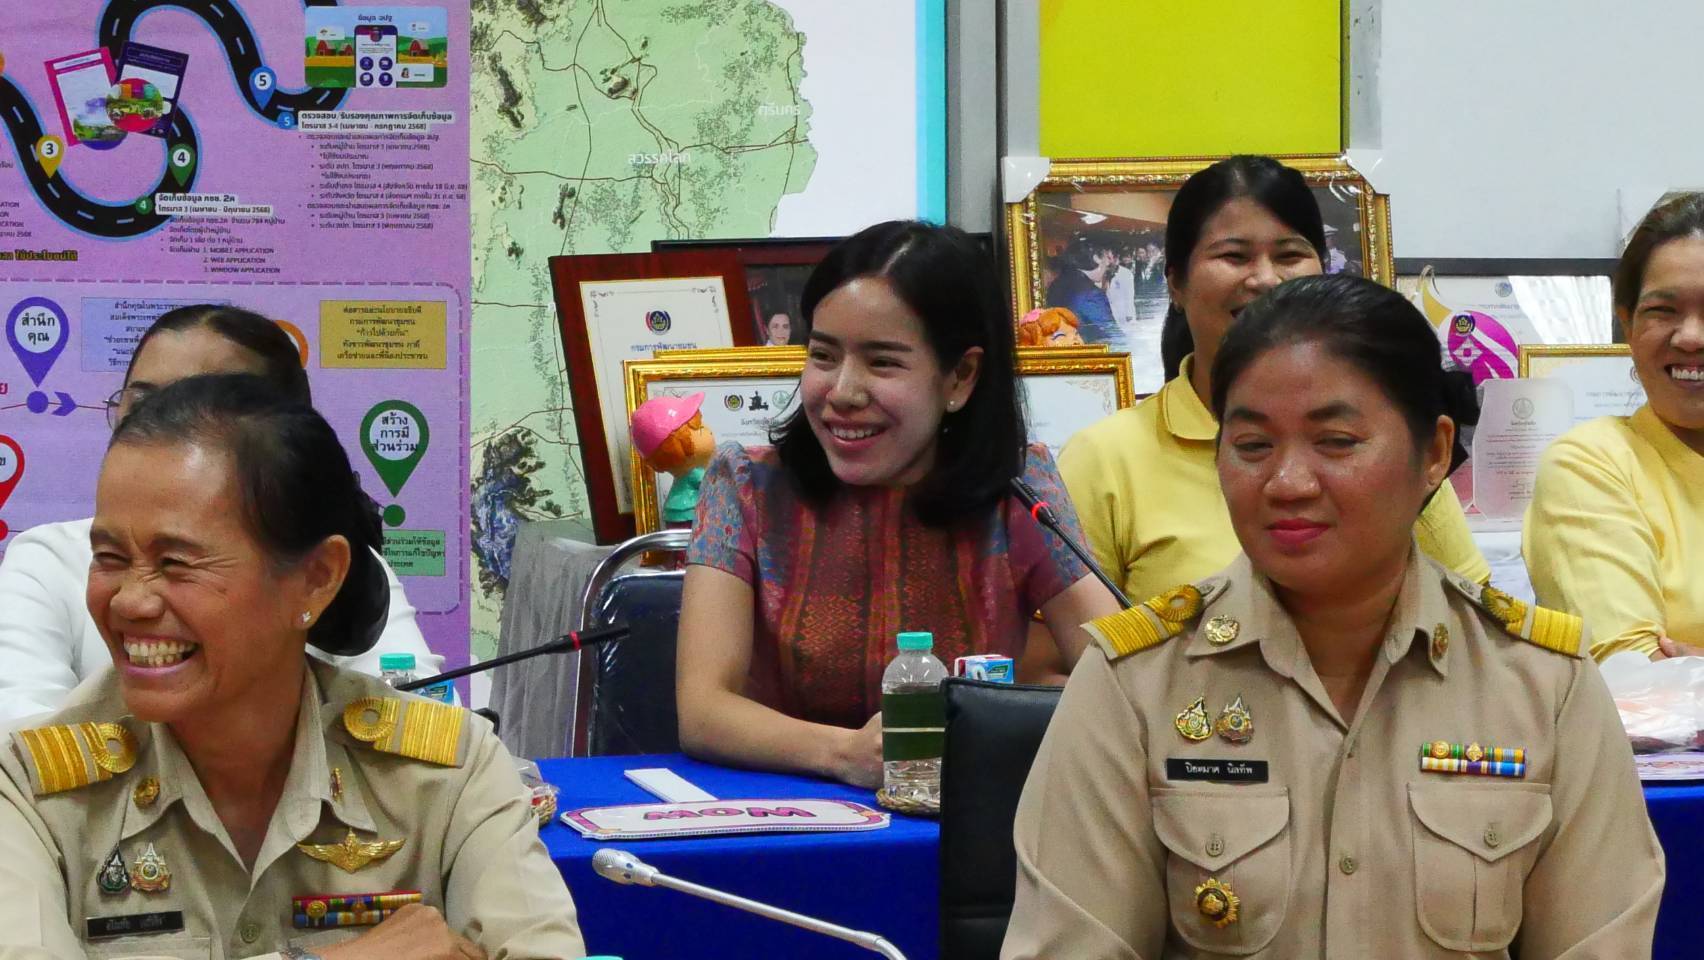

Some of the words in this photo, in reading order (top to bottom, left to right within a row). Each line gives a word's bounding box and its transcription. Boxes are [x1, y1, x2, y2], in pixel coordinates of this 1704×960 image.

[257, 74, 269, 87] 5
[283, 115, 291, 126] 5
[46, 143, 54, 155] 3
[177, 151, 187, 163] 4
[140, 200, 147, 210] 4
[21, 312, 55, 327] สำนึก
[27, 331, 50, 345] คุณ
[381, 411, 408, 425] สร้าง
[380, 426, 409, 438] การมี
[373, 439, 418, 452] ส่วนร่วม
